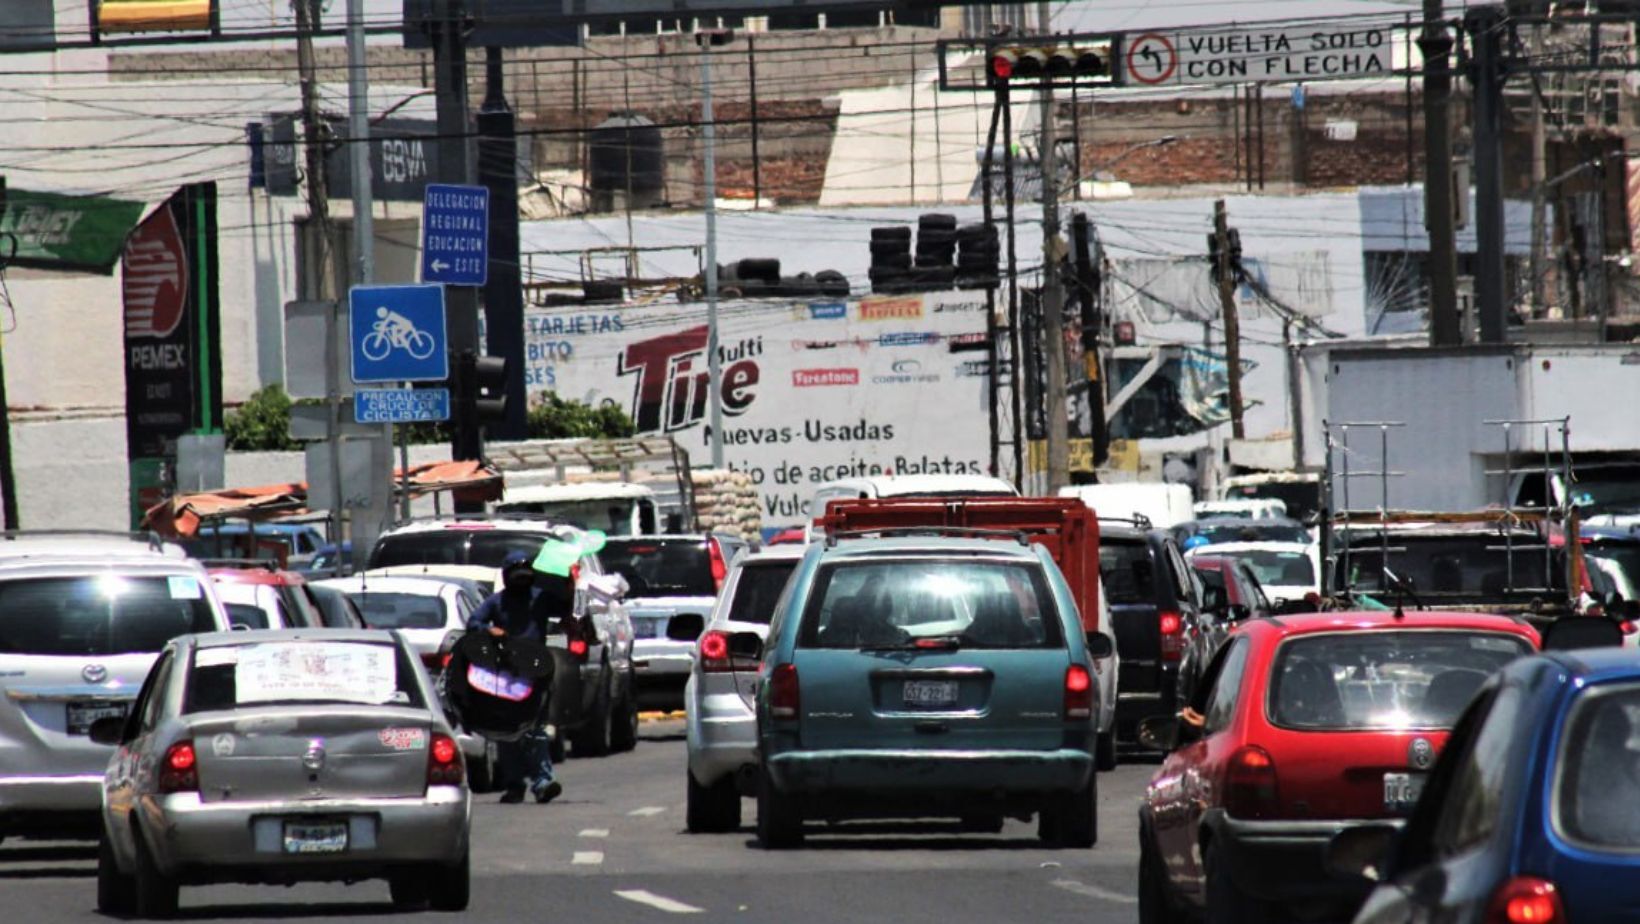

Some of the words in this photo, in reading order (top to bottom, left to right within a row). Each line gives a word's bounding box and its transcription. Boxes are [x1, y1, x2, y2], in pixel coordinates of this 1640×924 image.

[1188, 33, 1291, 55] VUELTA
[1310, 30, 1383, 50] SOLO
[1187, 59, 1247, 78] CON
[1265, 53, 1384, 75] FLECHA
[381, 139, 427, 182] BBVA
[427, 191, 486, 210] DELEGACION
[430, 213, 482, 231] REGIONAL
[428, 235, 483, 252] EDUCACION
[455, 257, 481, 274] ESTE
[527, 314, 625, 336] TARJETAS
[131, 344, 184, 370] PEMEX
[362, 391, 442, 401] PRECAUCION
[367, 400, 414, 411] CRUCE
[774, 459, 802, 485] de
[809, 457, 883, 483] aceite
